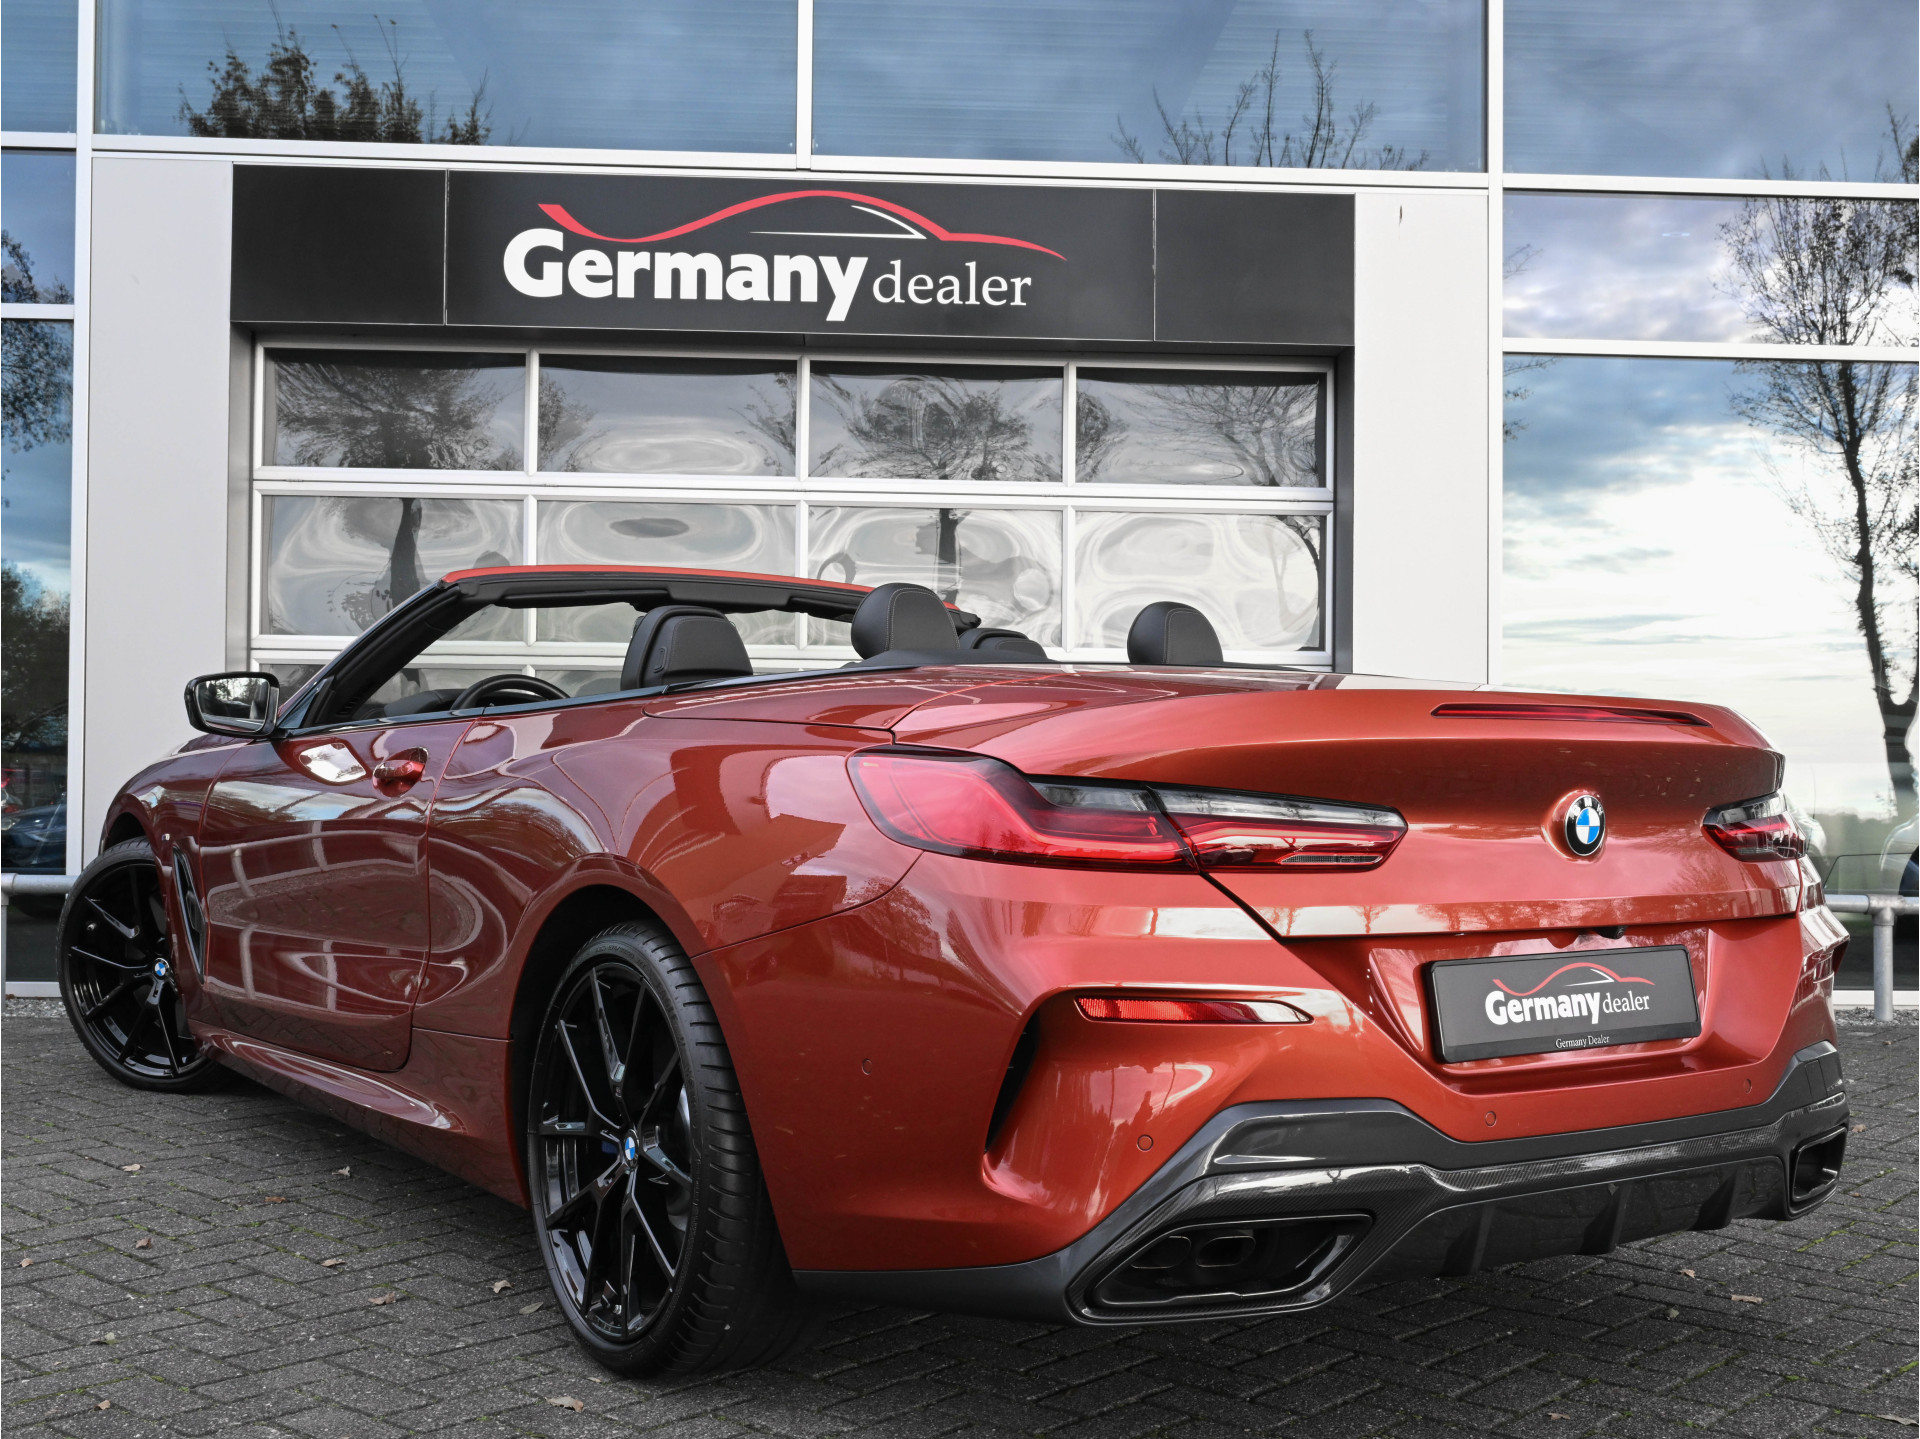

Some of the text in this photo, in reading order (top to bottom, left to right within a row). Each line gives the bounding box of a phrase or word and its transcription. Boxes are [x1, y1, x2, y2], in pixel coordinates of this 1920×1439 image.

[503, 227, 1032, 322] Germany dealer
[1485, 990, 1650, 1025] Germany dealer
[1555, 1034, 1610, 1049] Germany Dealer
